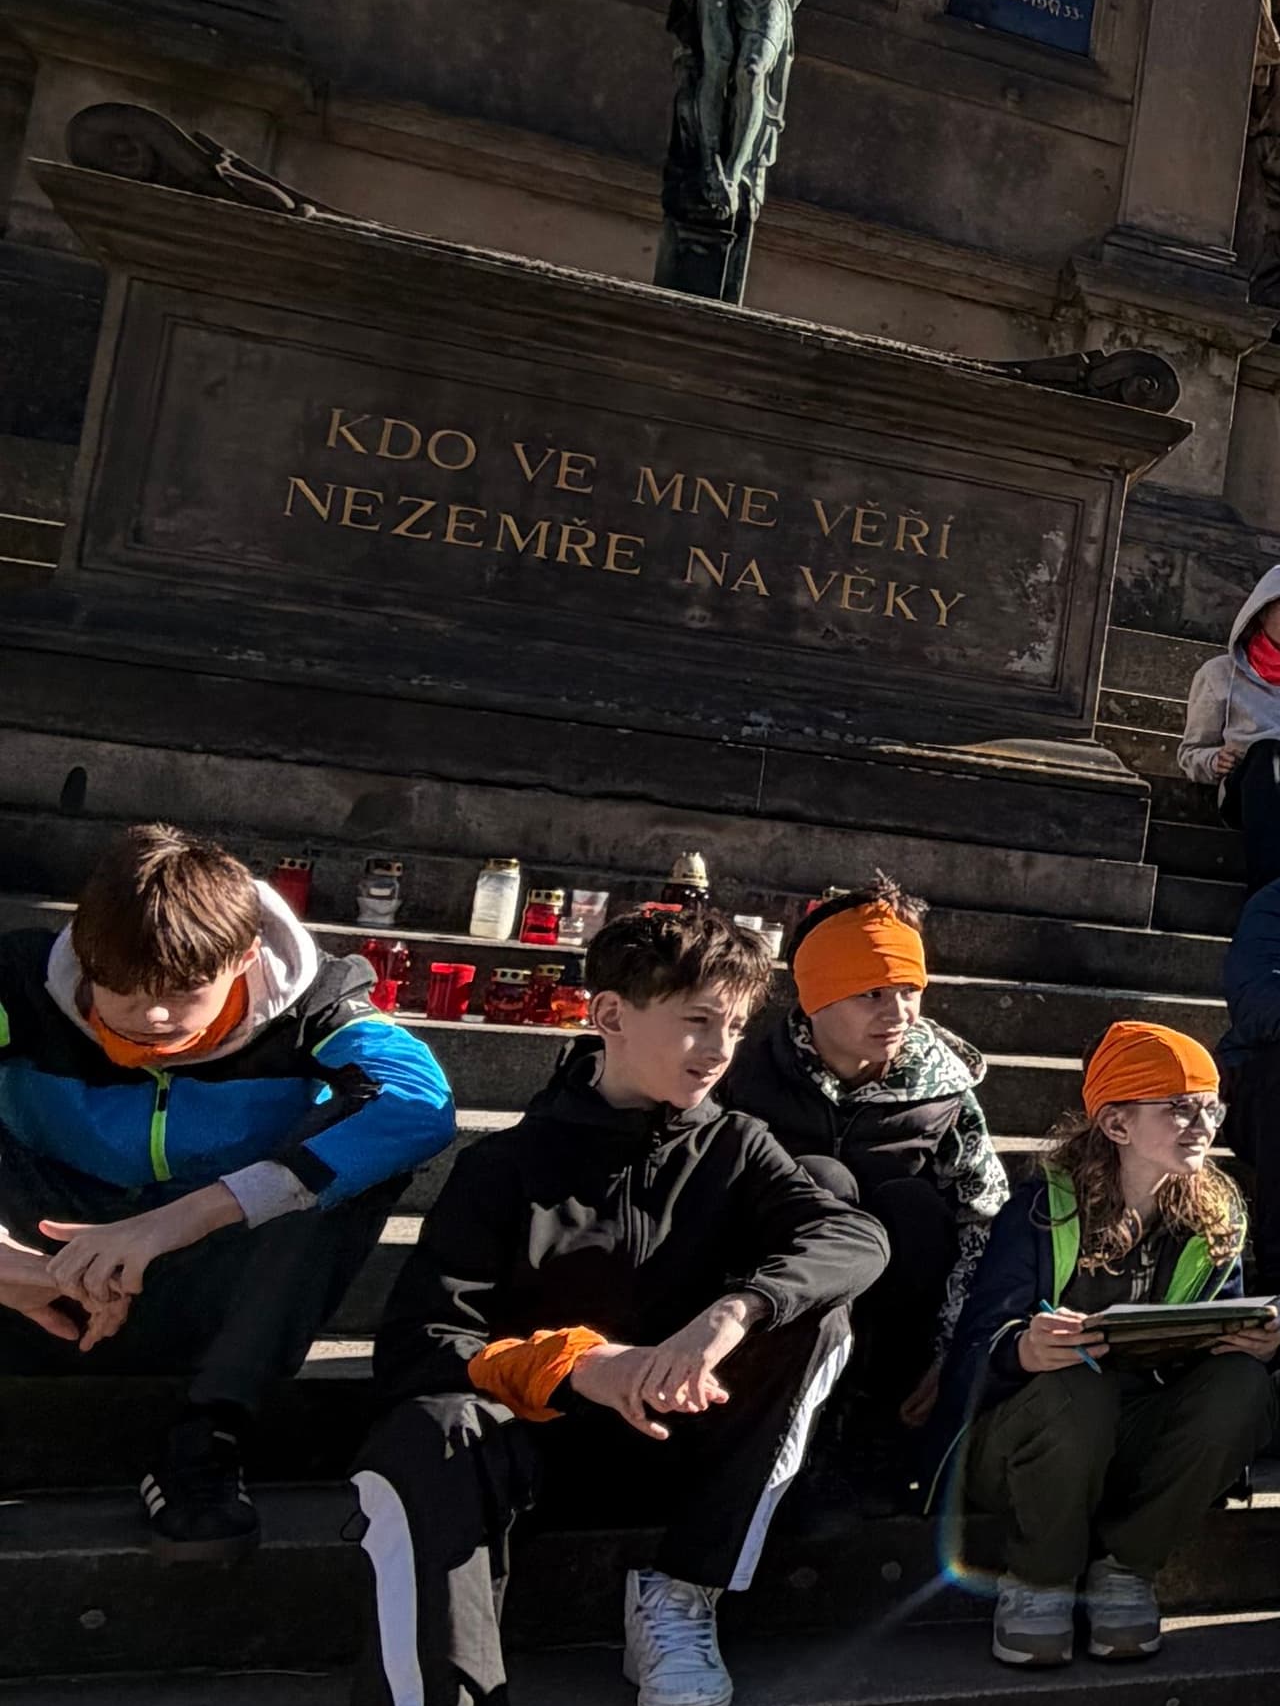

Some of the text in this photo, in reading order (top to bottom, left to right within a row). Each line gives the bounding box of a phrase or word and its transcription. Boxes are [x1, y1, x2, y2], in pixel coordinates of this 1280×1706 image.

[283, 476, 967, 629] NEZEMŘE NA VĚKY
[326, 406, 956, 560] KDO VE MNE VĚŘÍ
